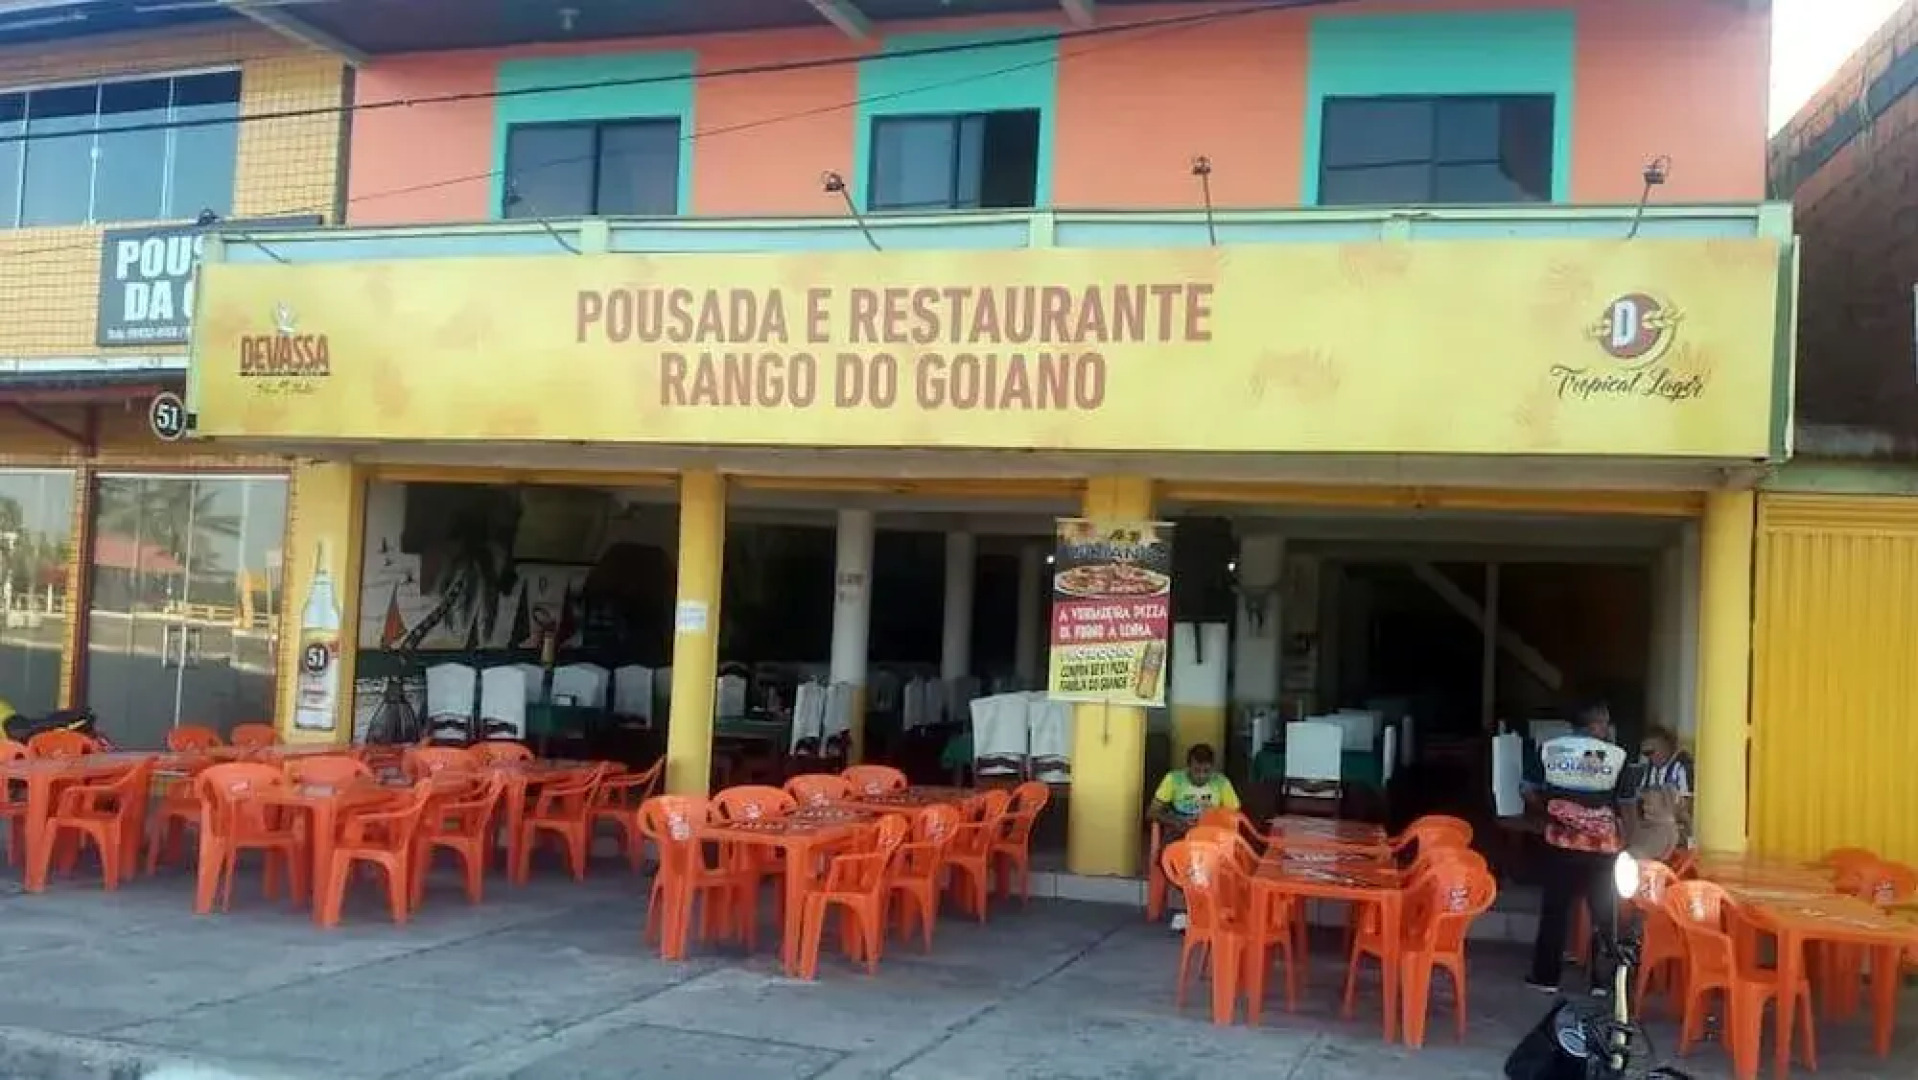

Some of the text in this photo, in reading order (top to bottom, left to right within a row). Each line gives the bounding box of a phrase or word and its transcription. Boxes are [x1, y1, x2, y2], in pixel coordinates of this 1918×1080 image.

[123, 281, 174, 321] DA
[576, 284, 1214, 343] POUSADA E RESTAURANTE
[1612, 300, 1637, 347] D
[240, 335, 330, 370] DEVASSA
[660, 352, 1107, 410] RANGO DO GOIANO
[1550, 364, 1642, 399] Tropical
[156, 405, 180, 430] 51
[1133, 603, 1167, 619] PIZZA
[307, 649, 326, 667] 51
